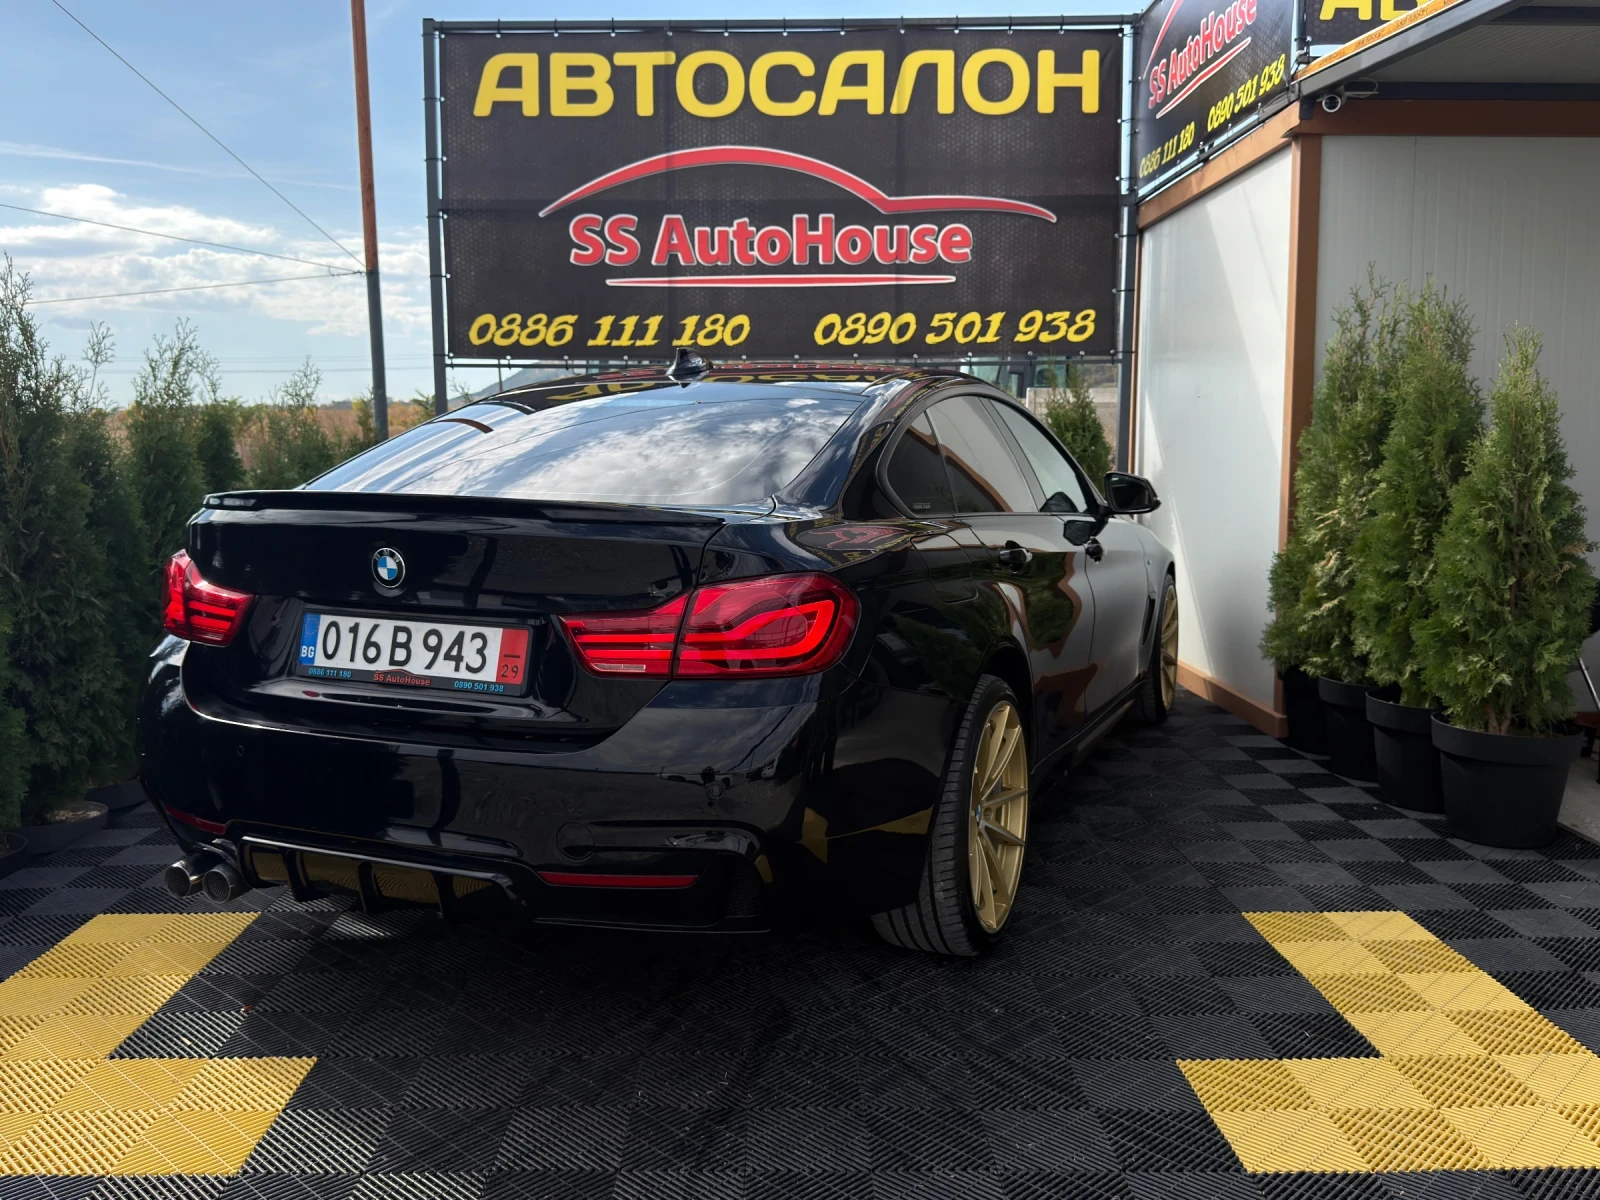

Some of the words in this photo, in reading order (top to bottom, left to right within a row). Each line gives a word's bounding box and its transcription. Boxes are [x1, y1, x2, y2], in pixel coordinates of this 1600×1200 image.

[1148, 58, 1167, 109] SS
[1167, 0, 1257, 95] AutoHouse
[473, 49, 1101, 118] АВТОСАЛОН
[1207, 93, 1235, 132] 0890
[1234, 75, 1259, 113] 501
[1259, 53, 1286, 97] 938
[1139, 147, 1162, 179] 0886
[1161, 135, 1179, 165] 111
[1177, 121, 1195, 154] 180
[569, 214, 640, 266] SS
[653, 214, 973, 266] AutoHouse
[468, 313, 579, 347] 0886
[587, 314, 663, 347] 111
[673, 313, 751, 347] 180
[813, 312, 917, 345] 0890
[925, 311, 1007, 345] 501
[1014, 309, 1097, 343] 938
[301, 646, 315, 658] BG
[308, 667, 326, 677] 0886
[326, 669, 338, 678] 111
[338, 670, 352, 678] 180
[373, 673, 384, 682] SS
[386, 675, 431, 686] AutoHouse
[454, 680, 473, 690] 0890
[474, 682, 488, 691] 501
[489, 684, 504, 692] 938
[500, 664, 519, 678] 29
